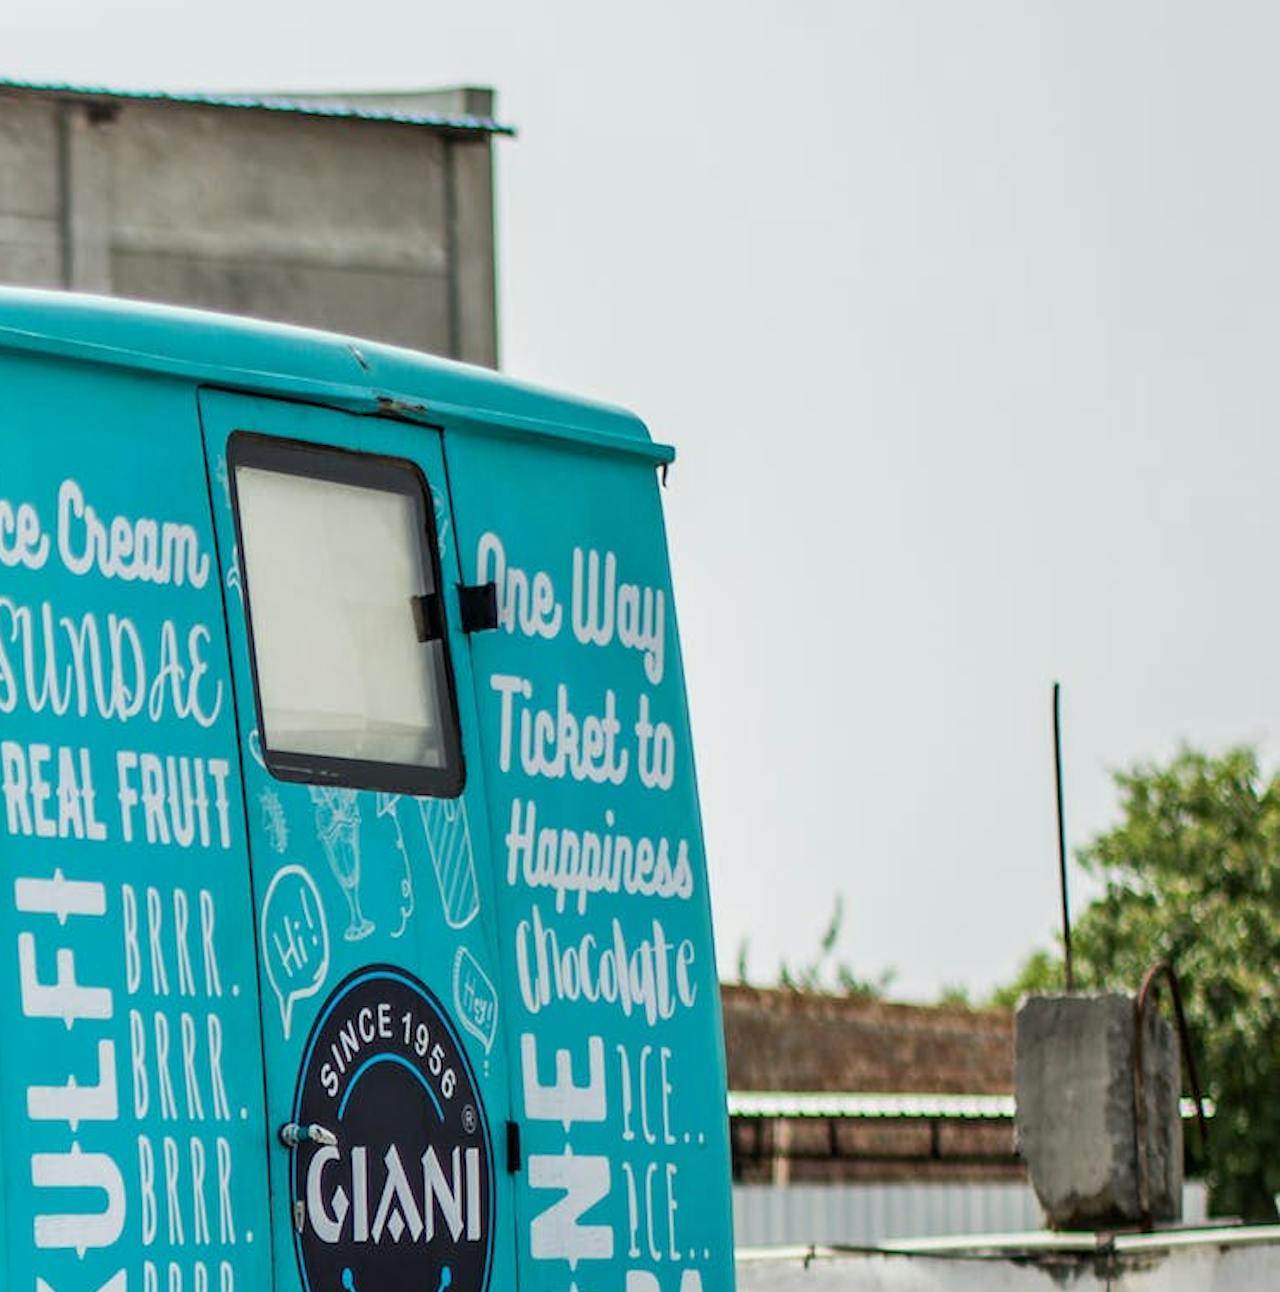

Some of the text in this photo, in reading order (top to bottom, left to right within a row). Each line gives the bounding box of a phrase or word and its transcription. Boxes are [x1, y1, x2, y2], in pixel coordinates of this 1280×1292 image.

[58, 480, 210, 588] Cream
[477, 532, 666, 686] One Way
[490, 674, 675, 790] Ticket to
[1, 741, 230, 848] REAL FRUIT
[506, 797, 695, 916] Happiness
[122, 884, 239, 997] BRRR.
[272, 886, 318, 978] Hi!
[130, 1009, 247, 1120] BRRR.
[320, 1003, 457, 1100] SINCE 1956
[138, 1135, 253, 1245] BRRR.
[306, 1143, 481, 1245] GIANI
